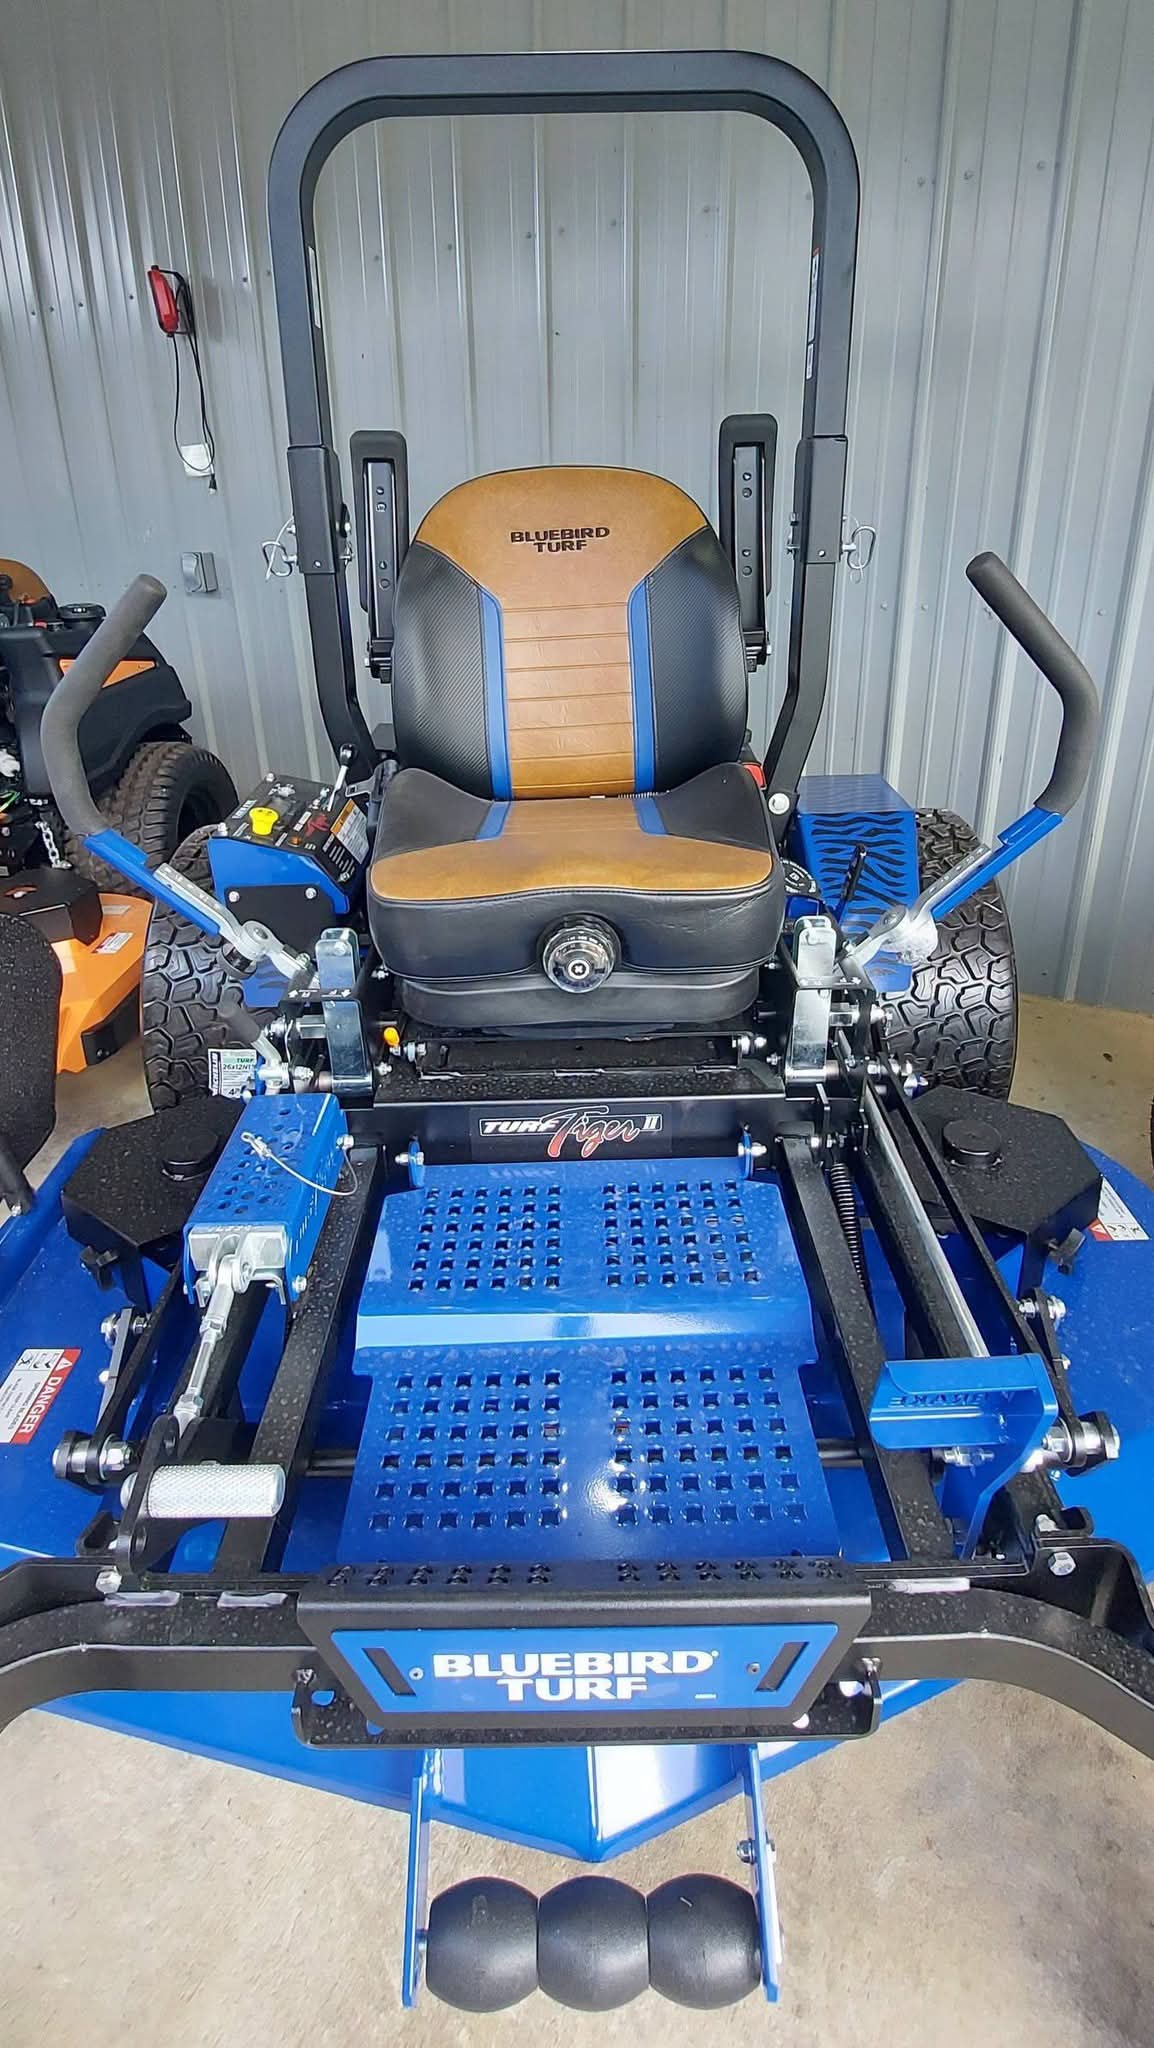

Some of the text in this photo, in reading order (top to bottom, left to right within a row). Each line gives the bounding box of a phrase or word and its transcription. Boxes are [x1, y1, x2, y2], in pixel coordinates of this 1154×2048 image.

[510, 527, 610, 543] BLUEBIRD
[533, 540, 588, 553] TURF
[482, 1105, 659, 1158] TURF Tiger II
[18, 1376, 63, 1434] DANGER
[433, 1650, 714, 1678] BLUEBIRD
[496, 1676, 648, 1702] TURF
